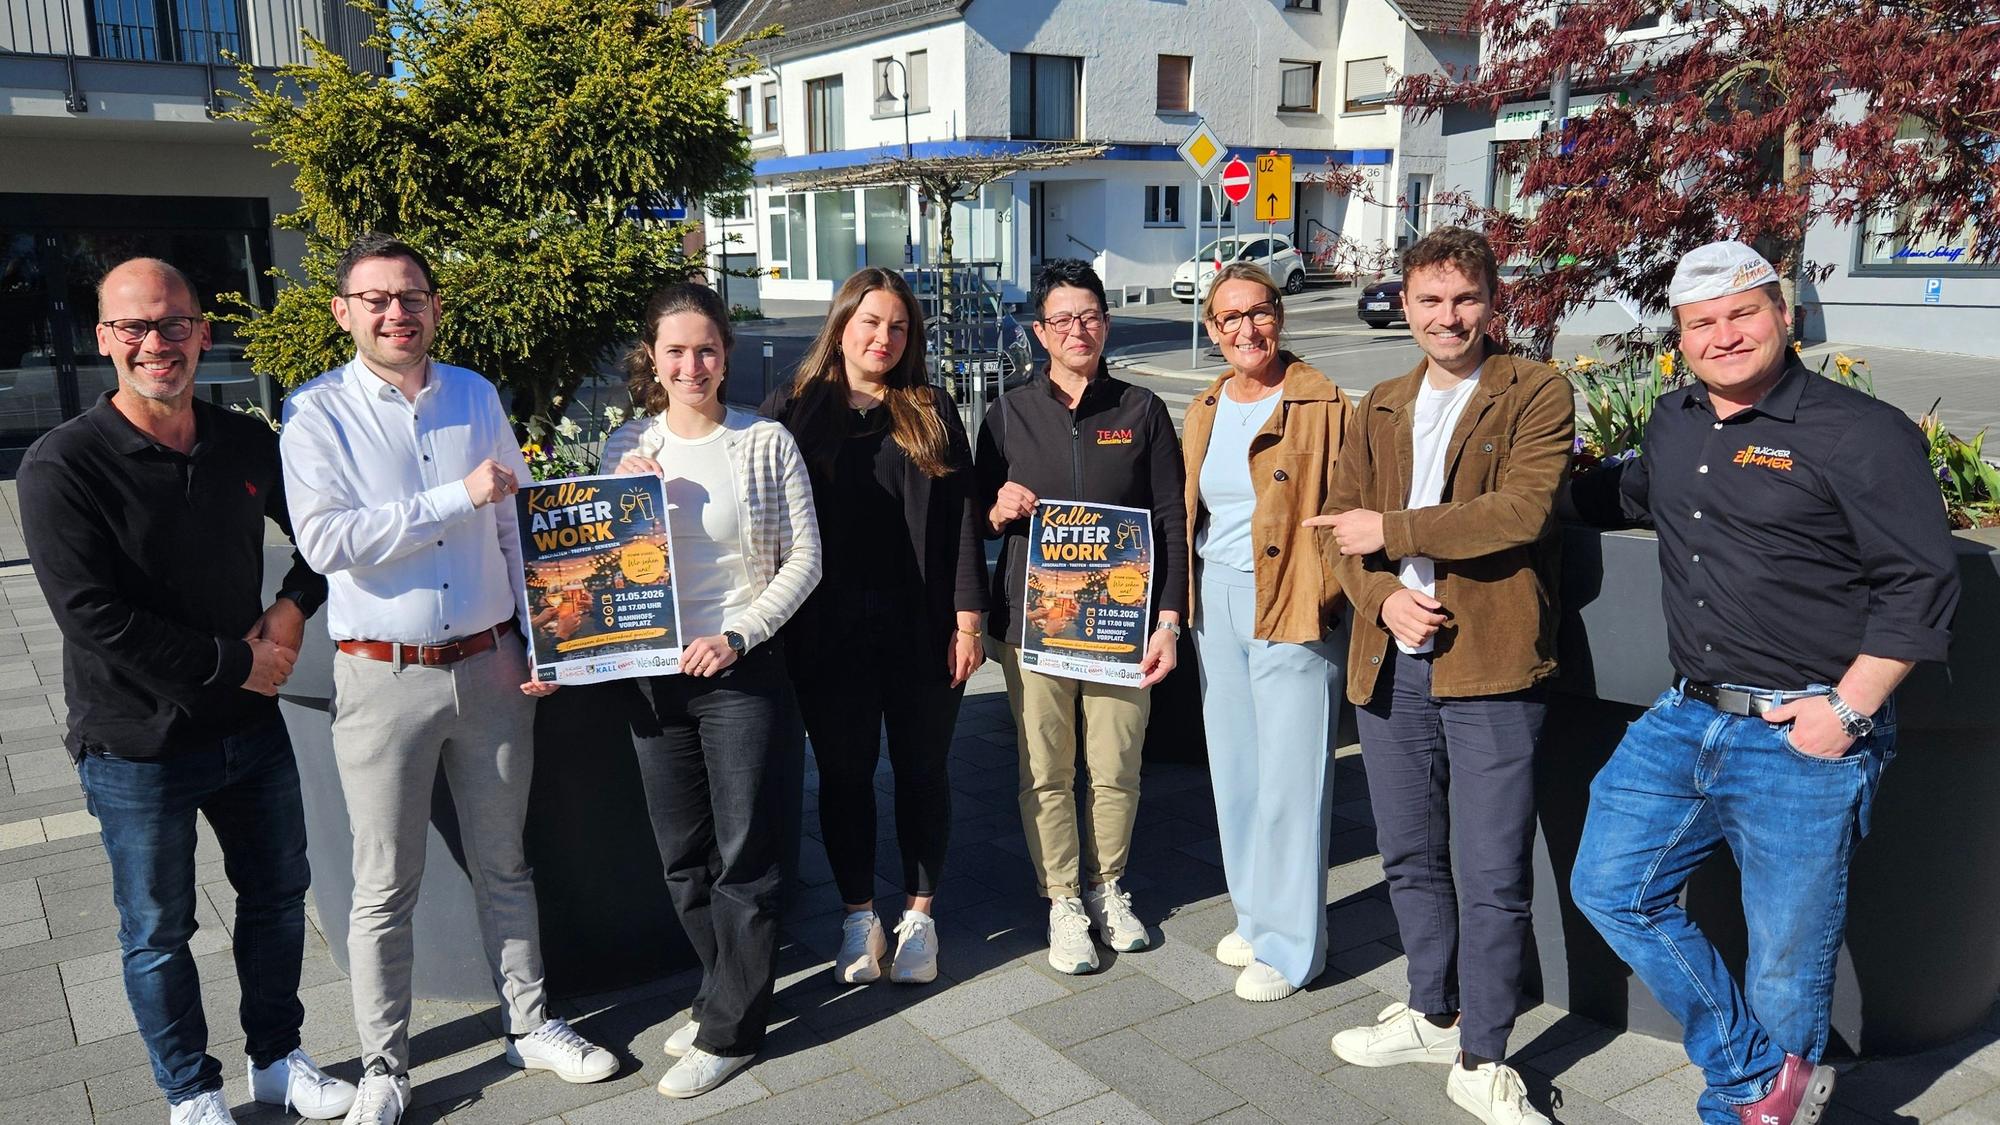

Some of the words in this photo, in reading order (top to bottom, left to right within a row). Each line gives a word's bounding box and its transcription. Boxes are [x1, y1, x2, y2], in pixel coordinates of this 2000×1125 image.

[1504, 110, 1540, 123] FIRST
[1259, 159, 1274, 172] U2
[1366, 168, 1380, 177] 36
[998, 210, 1011, 223] 36
[1927, 280, 1940, 293] P
[1096, 429, 1132, 439] TEAM
[1754, 446, 1791, 458] BÄCKER
[528, 483, 600, 515] Kaller
[531, 501, 613, 533] AFTER
[1042, 505, 1103, 528] Kaller
[532, 520, 615, 551] WORK
[1041, 526, 1110, 543] AFTER
[1041, 543, 1108, 561] WORK
[615, 589, 665, 602] 21.05.2026
[628, 603, 647, 611] 17.00
[1098, 608, 1139, 618] 21.05.2026
[596, 665, 617, 674] KALL
